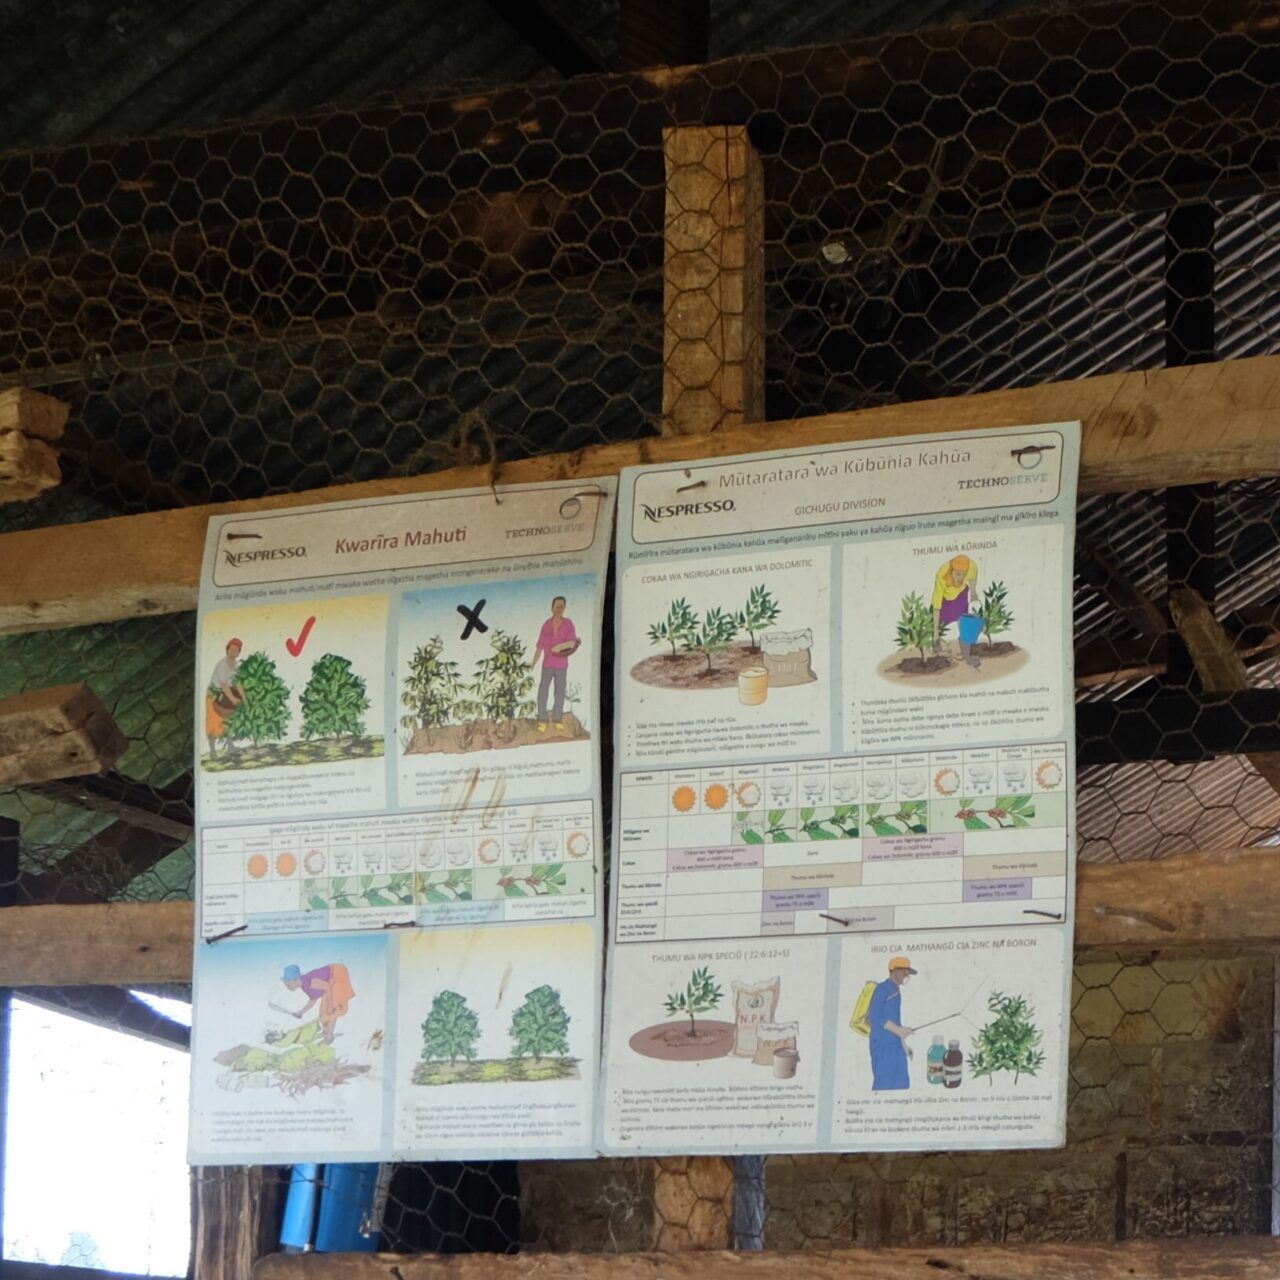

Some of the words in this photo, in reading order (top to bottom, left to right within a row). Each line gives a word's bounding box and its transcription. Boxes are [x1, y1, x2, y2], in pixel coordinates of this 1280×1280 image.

[816, 463, 838, 477] wa
[958, 473, 1048, 490] TECHNOSERVE
[640, 499, 735, 522] NESPRESSO
[794, 503, 840, 516] GICHUGU
[842, 497, 886, 510] DIVISION
[404, 526, 467, 547] Mahuti
[223, 546, 306, 567] NESPRESSO
[912, 546, 943, 556] THUMU
[945, 544, 959, 553] WA
[641, 574, 667, 584] COKAA
[669, 573, 682, 582] WA
[732, 565, 753, 575] KANA
[754, 563, 768, 572] WA
[770, 559, 813, 571] DOLOMITIC
[871, 945, 887, 953] IRIO
[889, 944, 903, 953] CIA
[971, 940, 990, 949] ZINC
[1007, 938, 1037, 947] BORON
[698, 953, 713, 961] NPK
